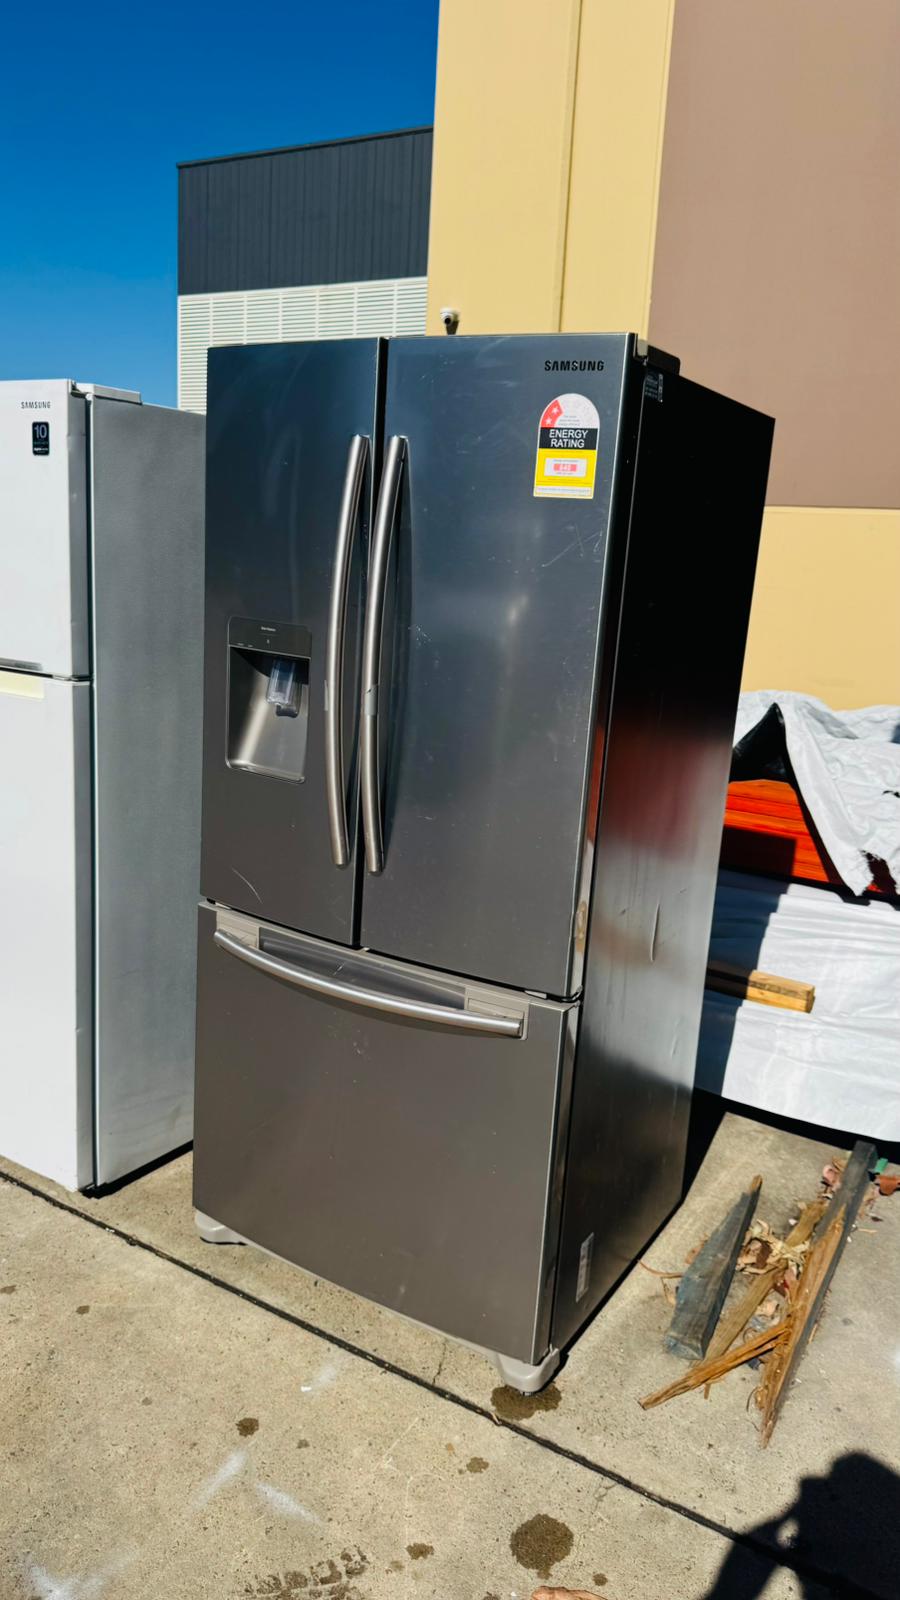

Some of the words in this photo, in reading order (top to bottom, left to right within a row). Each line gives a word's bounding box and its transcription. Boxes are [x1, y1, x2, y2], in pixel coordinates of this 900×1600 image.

[544, 360, 604, 371] SAMSUNG
[20, 401, 51, 409] SAMSUNG
[34, 424, 48, 439] 10
[549, 429, 588, 439] ENERGY
[550, 439, 585, 448] RATING
